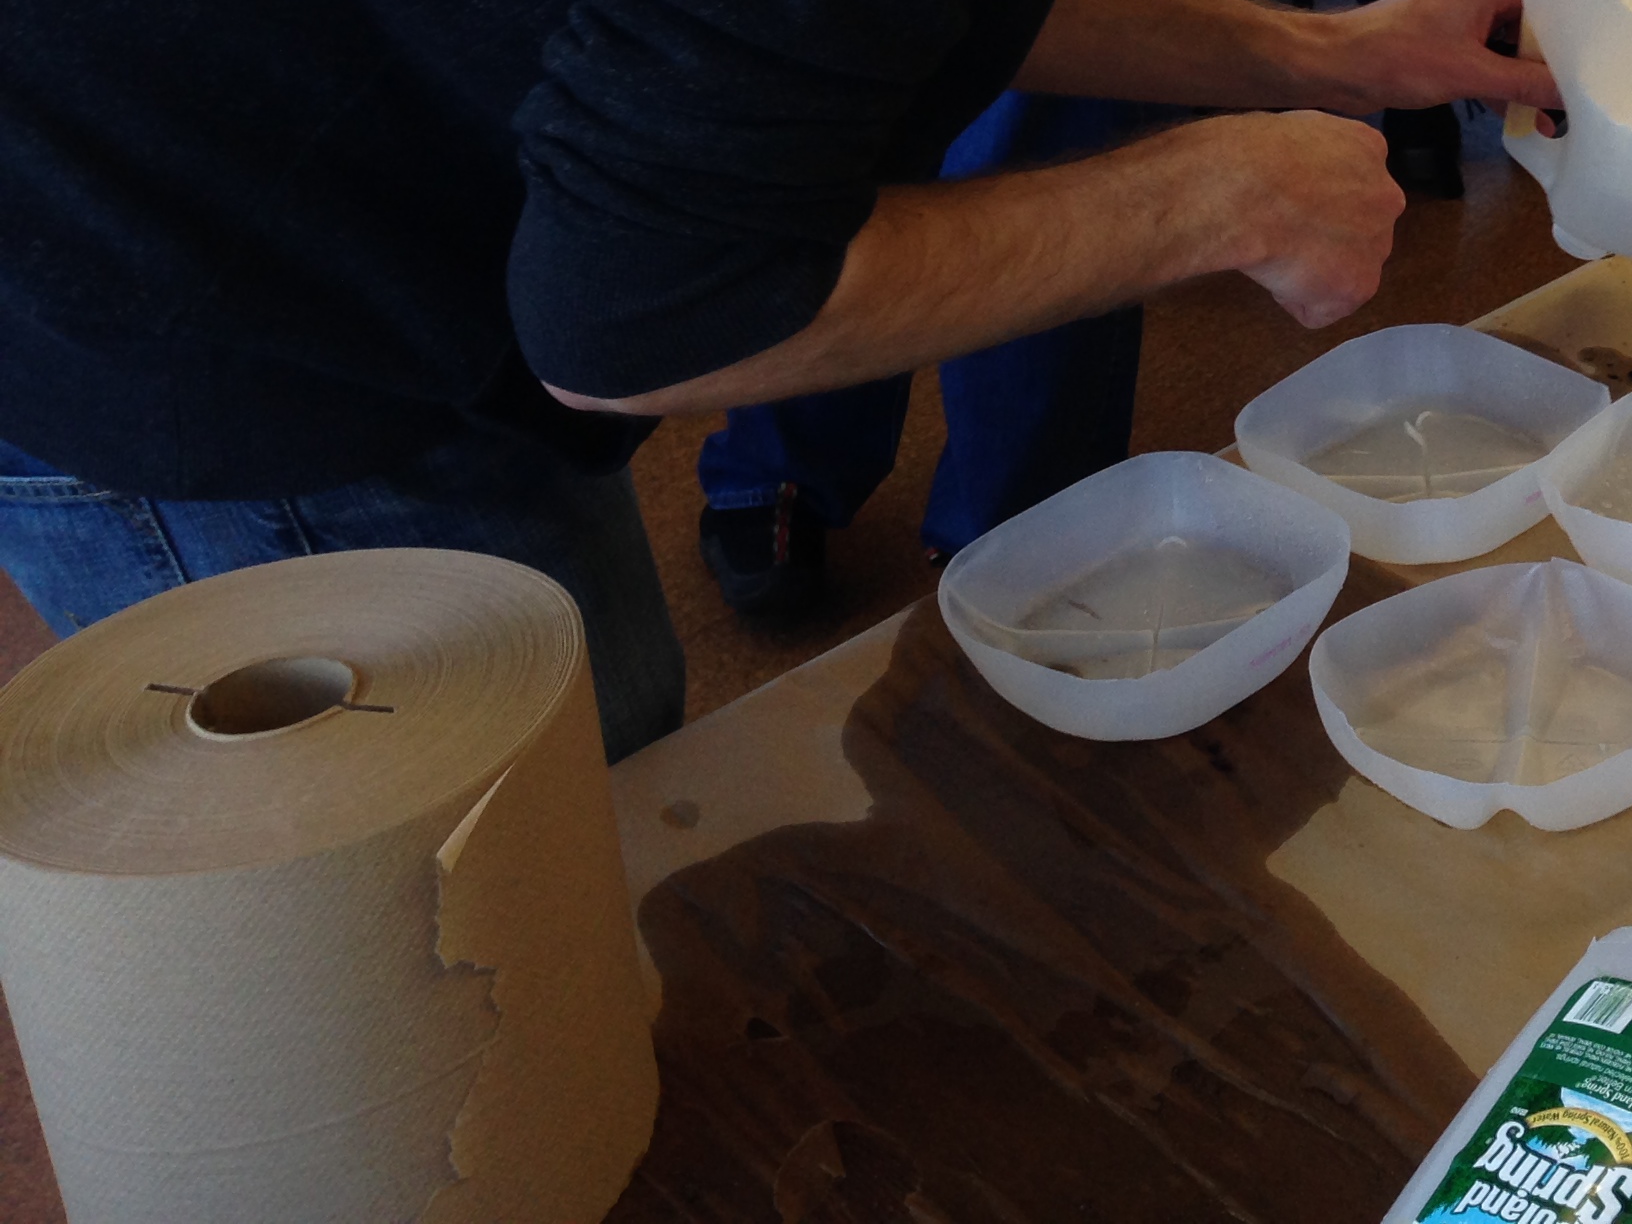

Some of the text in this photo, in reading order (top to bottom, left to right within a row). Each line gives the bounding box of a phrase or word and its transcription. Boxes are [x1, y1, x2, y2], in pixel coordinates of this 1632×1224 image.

[1581, 1078, 1612, 1098] Spring
[1531, 1112, 1560, 1123] Water
[1562, 1110, 1591, 1123] Spring
[1591, 1117, 1618, 1141] Natural
[1454, 1180, 1570, 1224] oland
